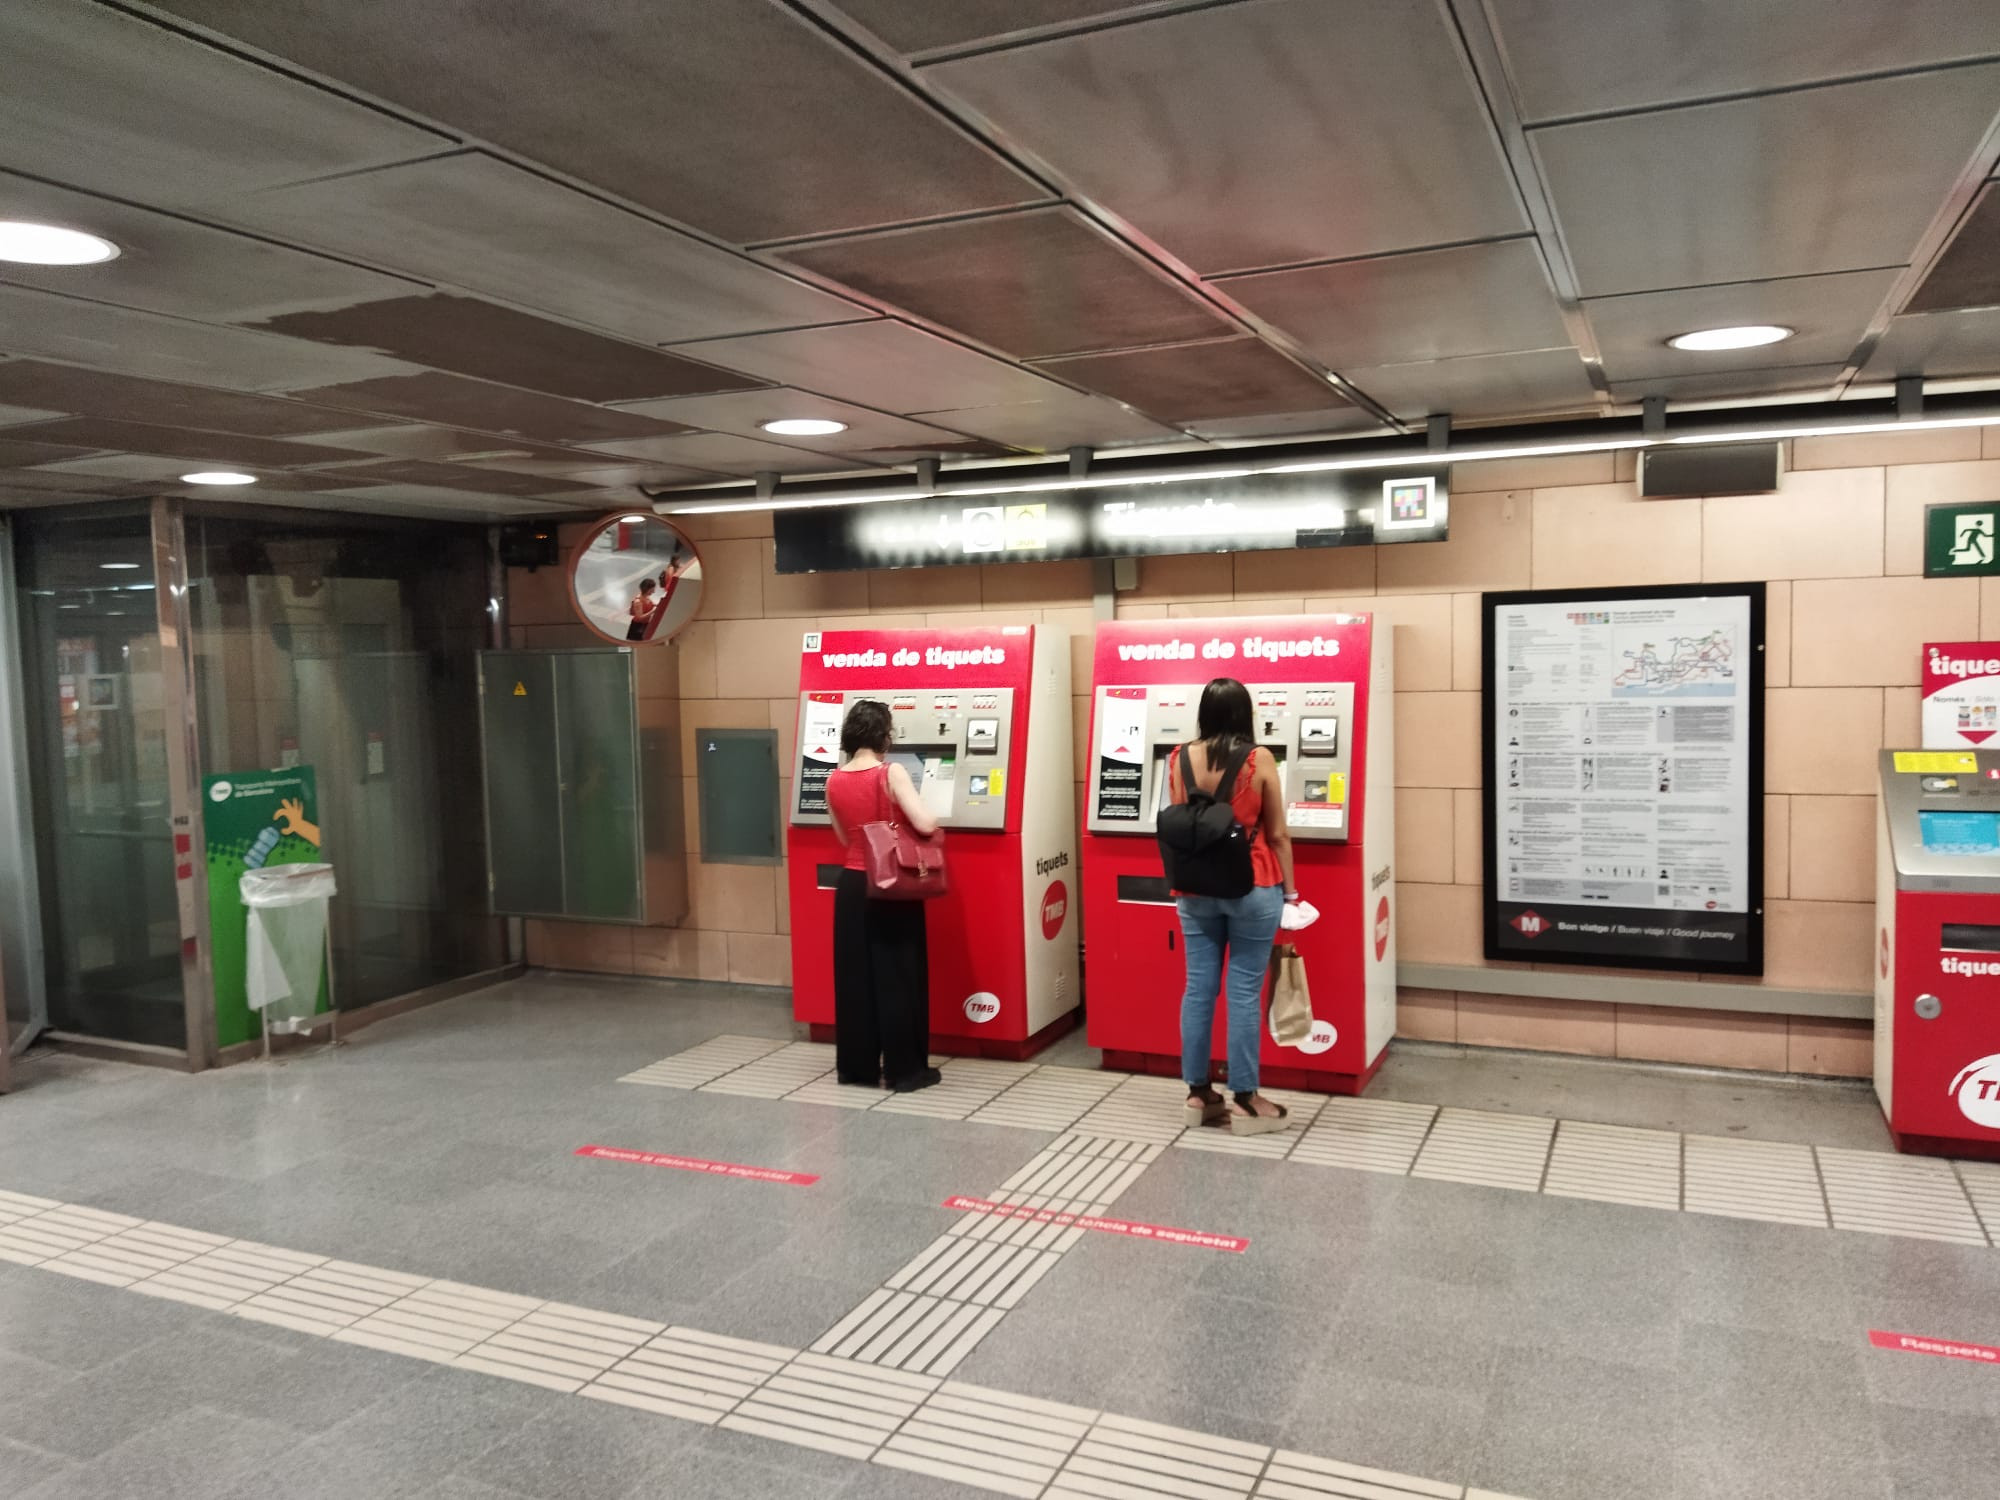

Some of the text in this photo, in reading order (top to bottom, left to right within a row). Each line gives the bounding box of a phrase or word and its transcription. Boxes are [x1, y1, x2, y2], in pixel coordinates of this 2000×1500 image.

[822, 646, 1005, 669] venda de tiquets
[1118, 636, 1340, 662] venda de tiquets
[1929, 656, 2000, 678] tique
[1036, 851, 1068, 877] tiquets
[1521, 916, 1540, 932] M
[1558, 922, 1578, 931] Bon
[1580, 923, 1609, 933] viatge
[1672, 928, 1698, 938] Good
[1699, 930, 1735, 941] journey
[1941, 957, 2000, 977] tique
[971, 1003, 995, 1013] TMB
[1131, 1225, 1152, 1235] de
[1156, 1229, 1237, 1248] seguretat
